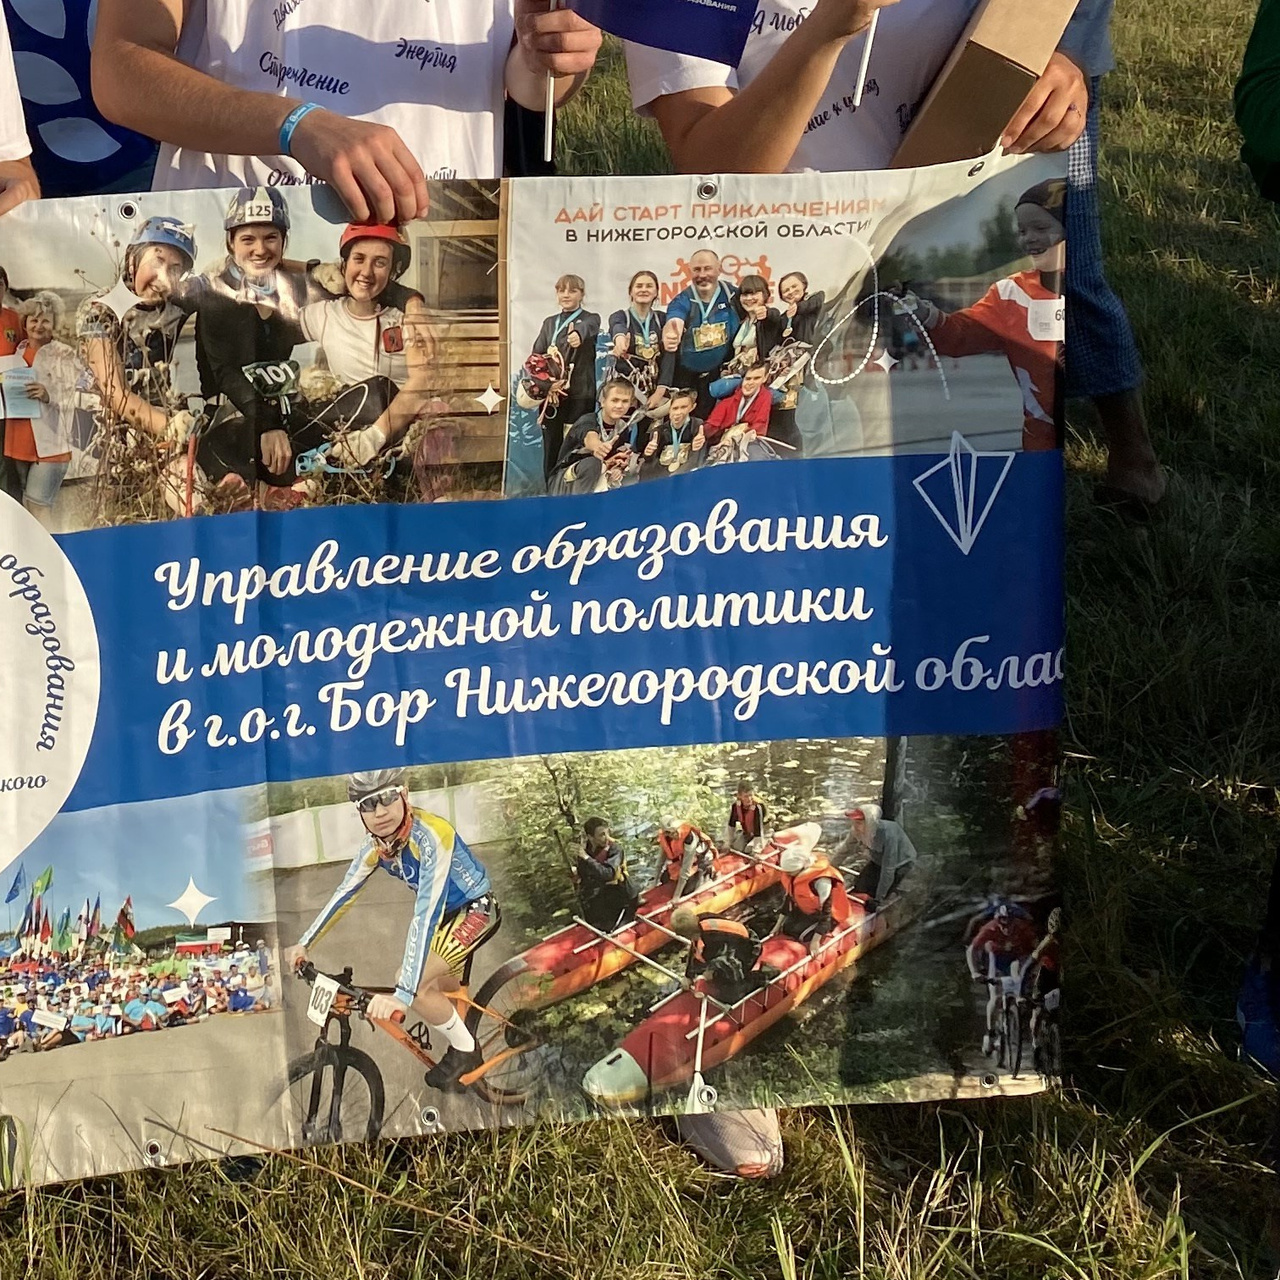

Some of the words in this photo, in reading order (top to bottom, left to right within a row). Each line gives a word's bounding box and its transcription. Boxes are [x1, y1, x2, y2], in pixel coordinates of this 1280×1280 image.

[750, 10, 765, 35] Я
[769, 7, 812, 32] люб
[395, 37, 457, 73] Энергия
[259, 51, 351, 95] Стремление
[247, 205, 271, 217] 125
[554, 203, 604, 224] ДАЙ
[613, 205, 682, 221] СТАРТ
[691, 198, 887, 219] ПРИКЛЮЧЕНИЯМ
[565, 229, 578, 243] В
[587, 220, 768, 243] НИЖЕГОРОДСКОЙ
[255, 362, 296, 385] 101
[154, 539, 503, 625] Управление
[511, 498, 890, 585] образования
[156, 647, 195, 686] и
[200, 589, 562, 680] молодежной
[569, 586, 875, 635] политики
[157, 698, 196, 756] в
[204, 701, 317, 749] г.о.г.
[317, 678, 437, 747] Бор
[444, 642, 905, 725] Нижегородской
[313, 984, 333, 1016] 103
